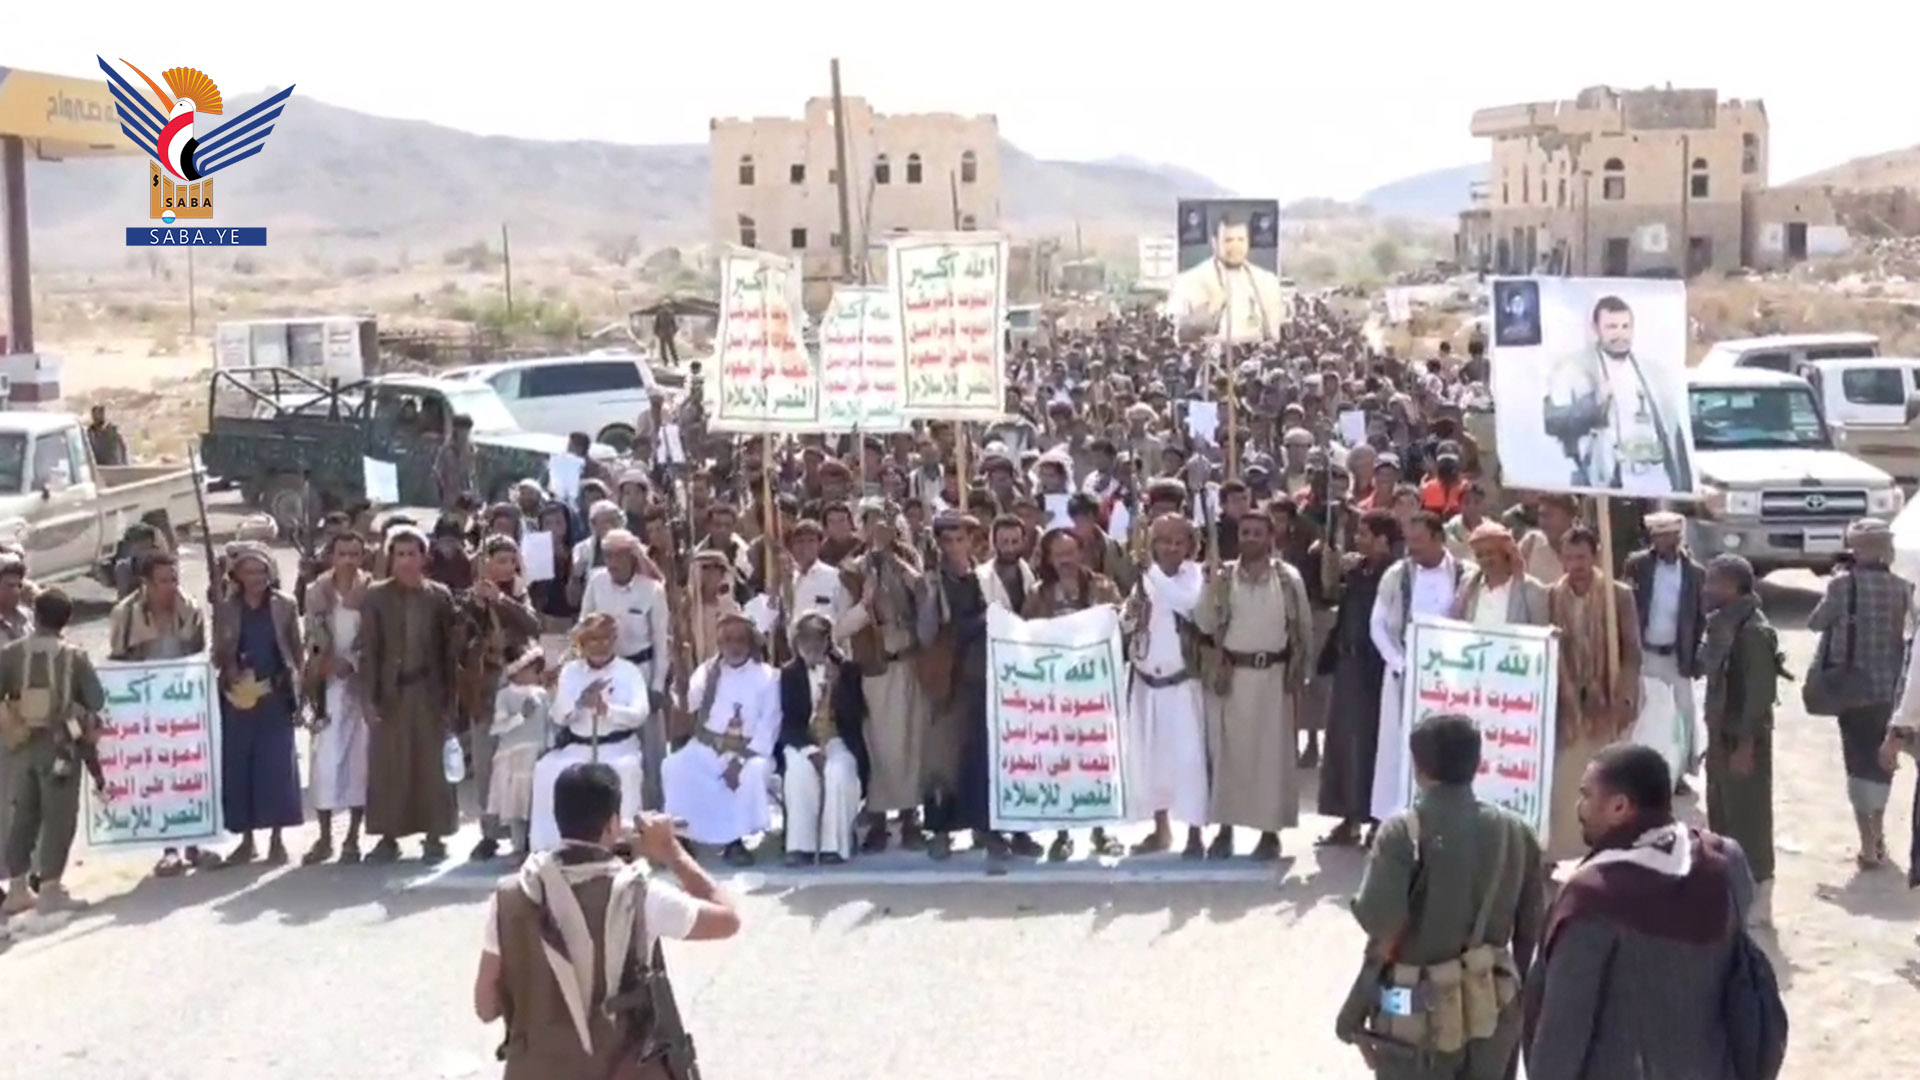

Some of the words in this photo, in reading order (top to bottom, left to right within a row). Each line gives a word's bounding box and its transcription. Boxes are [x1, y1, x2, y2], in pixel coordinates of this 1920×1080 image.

[1064, 655, 1108, 682] الله
[1495, 644, 1543, 677] الله
[162, 671, 206, 702] الله
[1067, 777, 1119, 814] النصر
[159, 799, 211, 834] النصر
